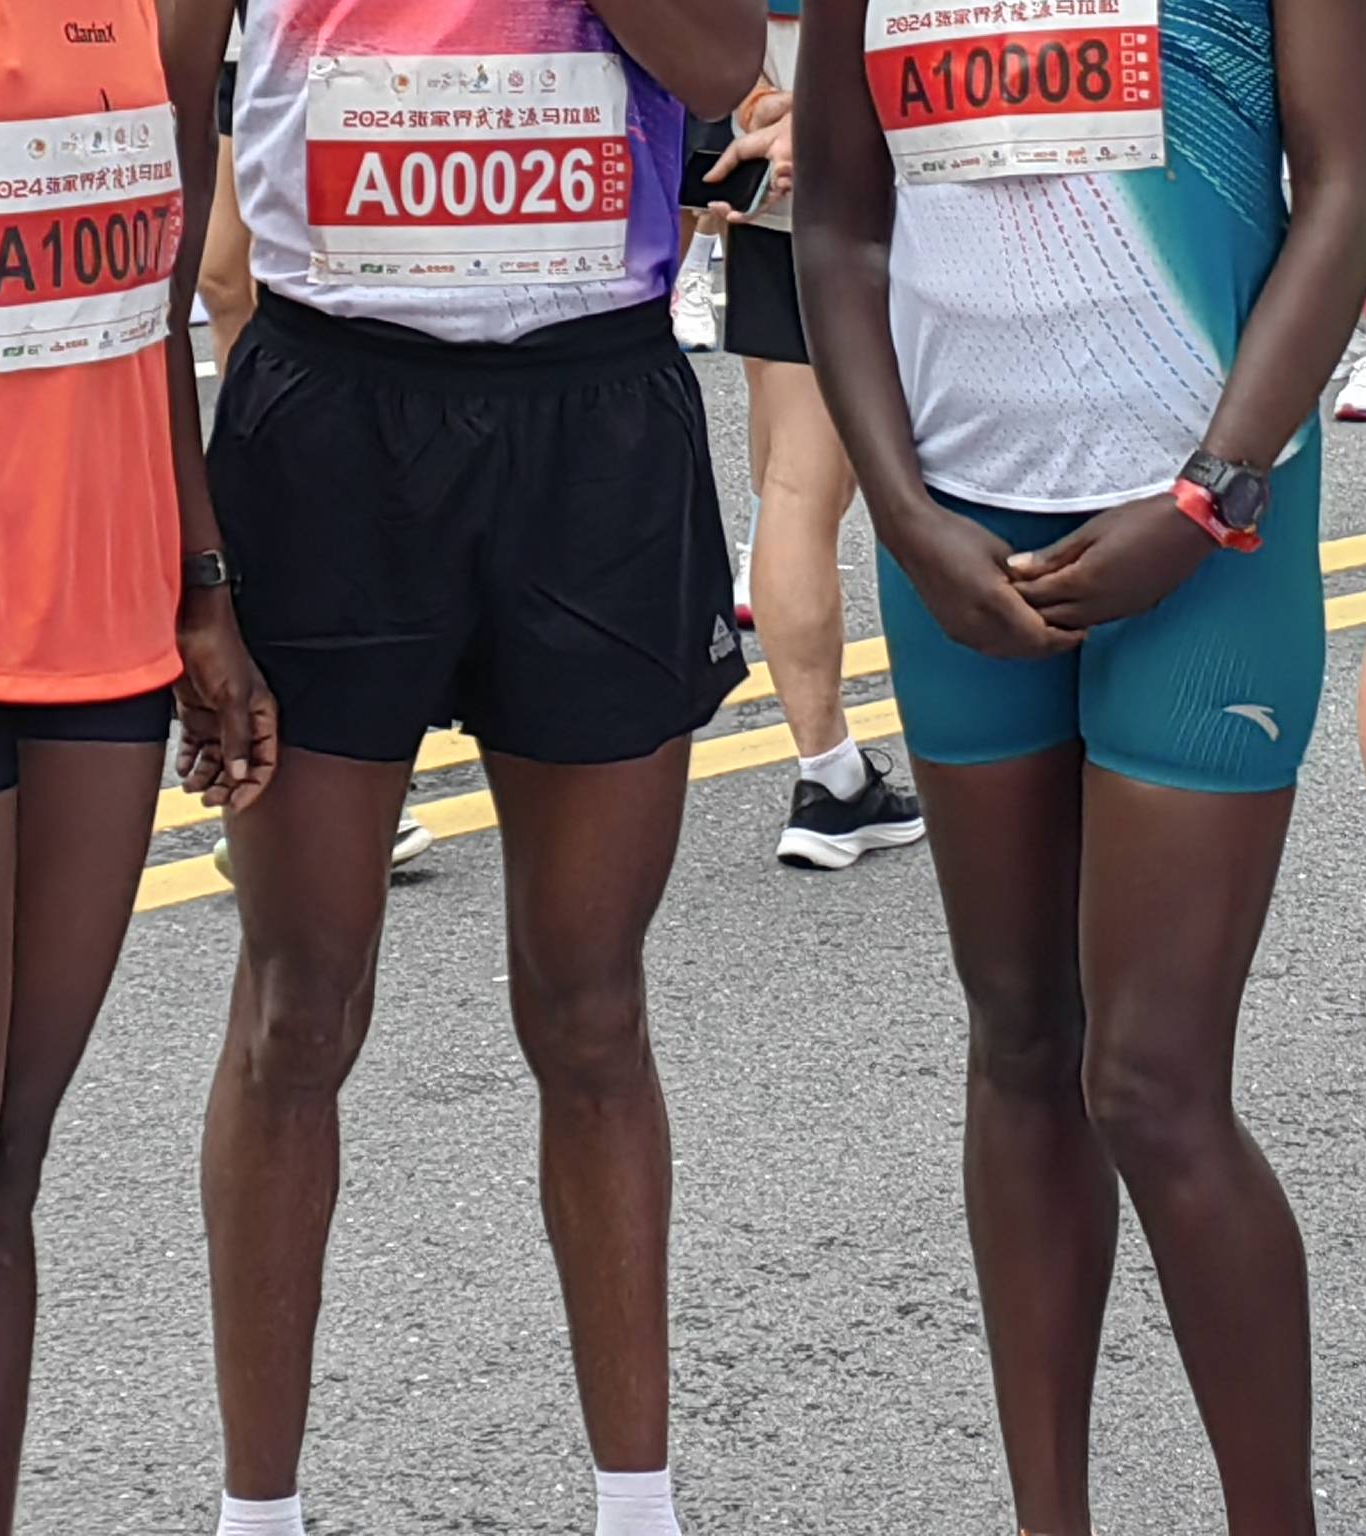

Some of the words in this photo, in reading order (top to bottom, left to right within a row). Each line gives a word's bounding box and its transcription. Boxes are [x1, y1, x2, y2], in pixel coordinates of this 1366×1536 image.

[899, 38, 1113, 118] A10008
[342, 105, 602, 130] 2024张家界武陵源马拉松
[345, 147, 596, 217] A00026
